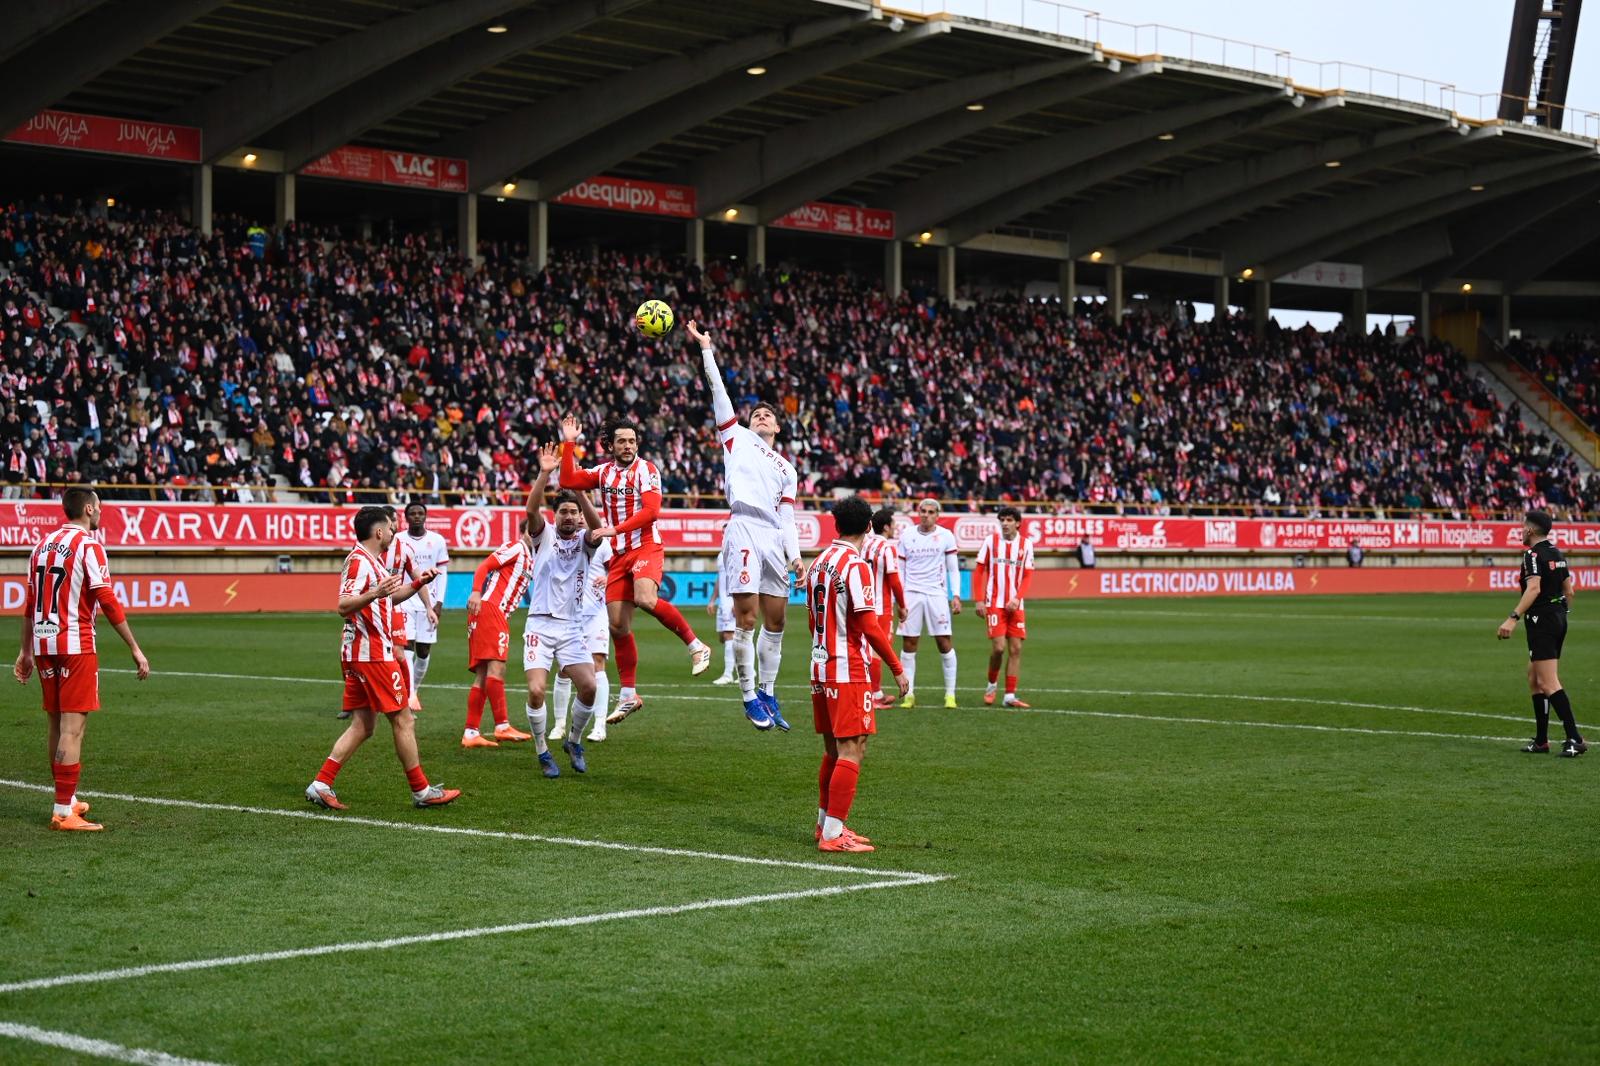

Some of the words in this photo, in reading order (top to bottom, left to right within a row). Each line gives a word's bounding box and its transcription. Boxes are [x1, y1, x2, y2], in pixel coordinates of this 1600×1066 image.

[117, 123, 176, 153] JUNGLA
[1045, 519, 1104, 535] SORLES
[1328, 524, 1341, 535] LA
[1441, 524, 1493, 548] hospitales
[740, 550, 750, 567] 7
[36, 565, 66, 613] 17
[1100, 572, 1218, 593] ELECTRICIDAD
[1223, 571, 1295, 592] VILLALBA
[814, 584, 826, 634] 6
[987, 614, 998, 627] 10
[391, 671, 402, 691] 2
[863, 690, 872, 712] 6
